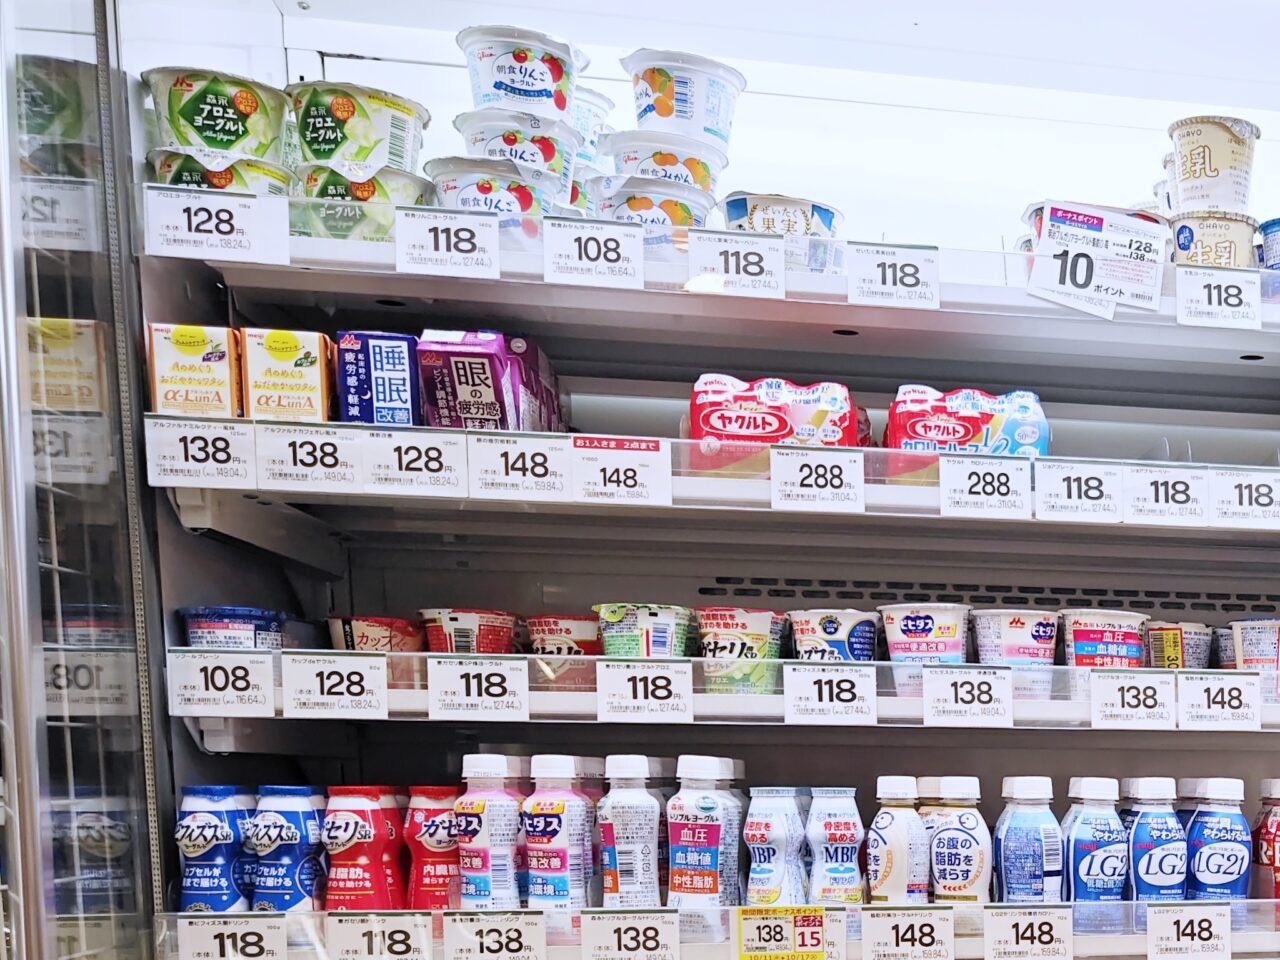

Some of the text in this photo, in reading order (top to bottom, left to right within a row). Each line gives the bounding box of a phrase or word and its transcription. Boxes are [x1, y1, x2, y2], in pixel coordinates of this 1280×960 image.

[761, 216, 798, 235] 果実
[376, 408, 410, 424] 改善
[718, 412, 774, 432] ヤクルト
[919, 421, 964, 439] ヤクルト
[679, 828, 709, 842] 血圧
[935, 836, 972, 851] お腹の
[675, 849, 715, 865] 血糖値
[824, 846, 857, 863] MBP
[934, 852, 973, 867] 脂肪を
[1195, 853, 1243, 875] LG21
[672, 874, 715, 888] 中性脂肪
[936, 868, 972, 881] 減らす
